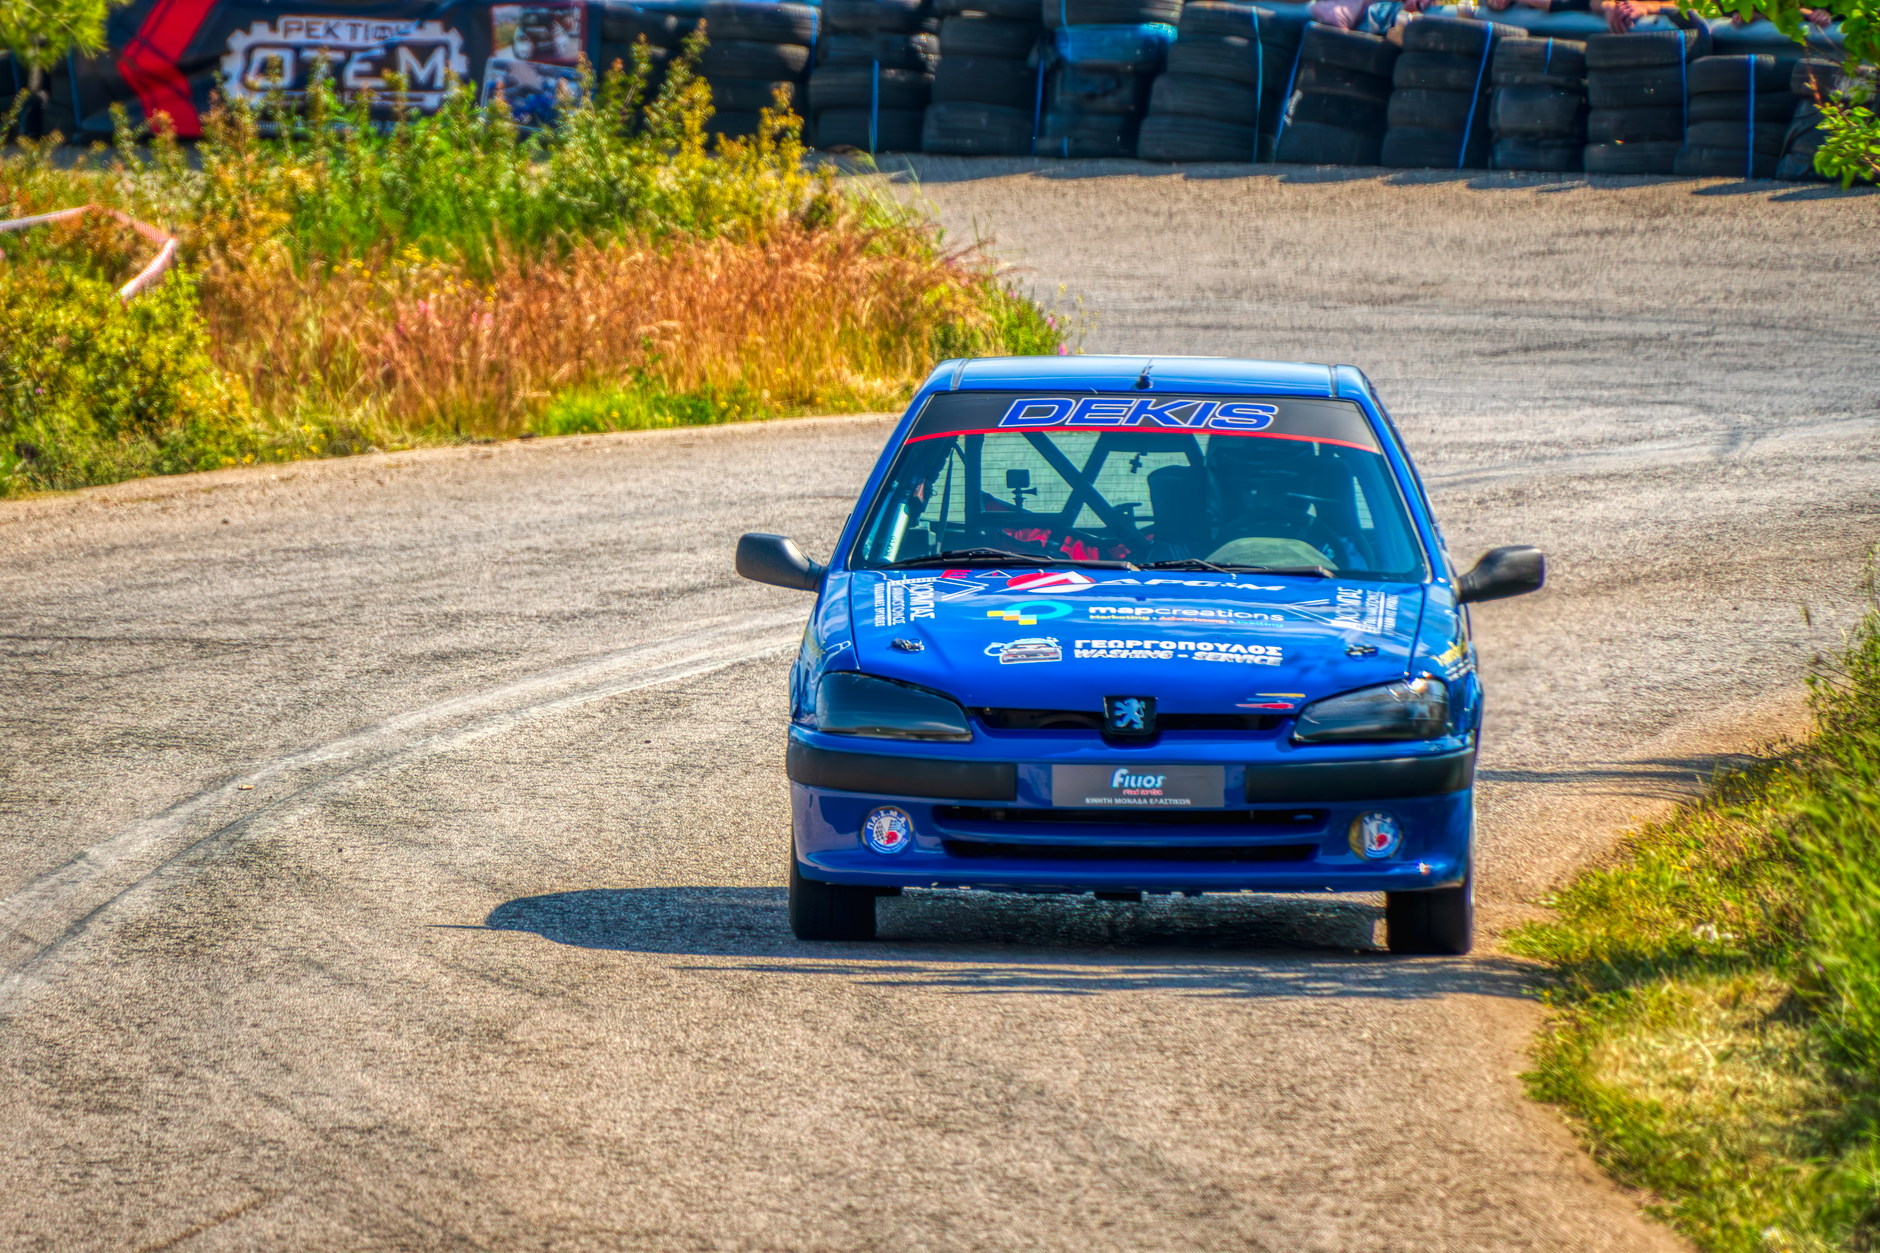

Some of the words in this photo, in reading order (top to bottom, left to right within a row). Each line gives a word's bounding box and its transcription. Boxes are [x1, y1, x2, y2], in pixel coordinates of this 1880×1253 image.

[998, 398, 1279, 430] DEKIS
[1088, 606, 1285, 622] mapcreations
[1075, 639, 1283, 656] ΓΕΩΡΓΟΠΟΥΛΟΣ
[1074, 649, 1174, 660] WASHING
[1192, 651, 1283, 666] SERVICE
[1114, 797, 1148, 805] ΜΟΝΑΔΑ
